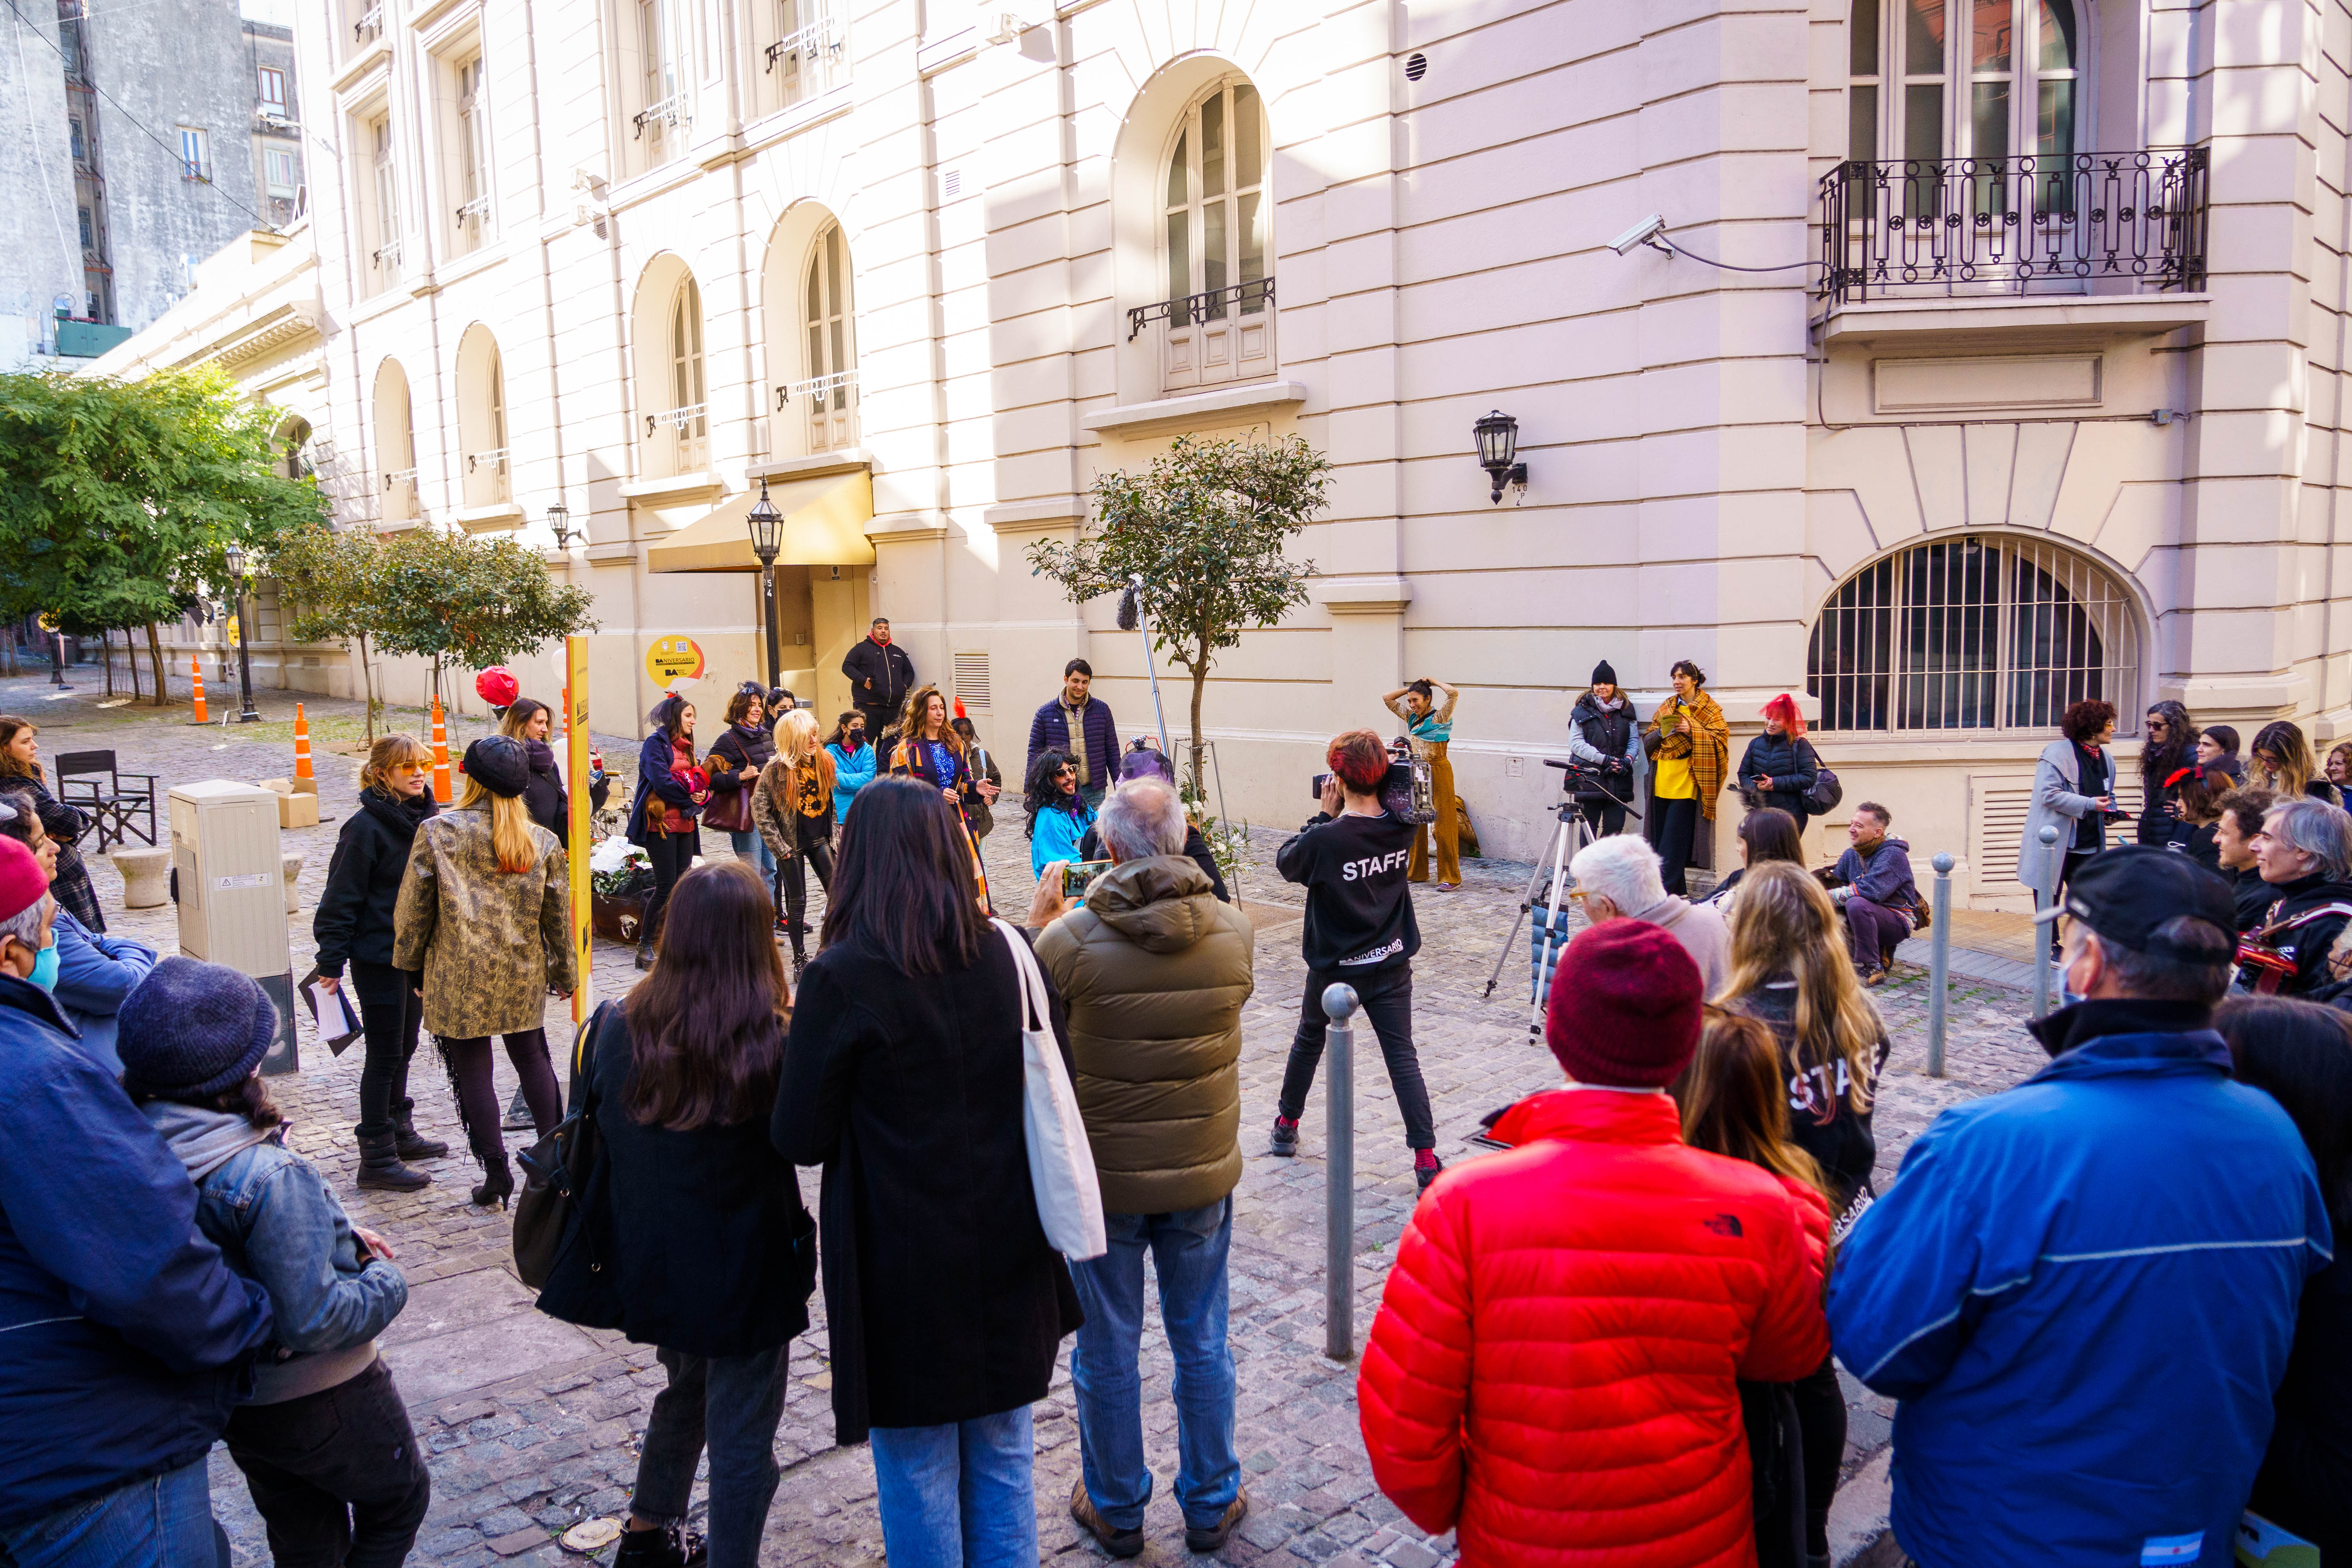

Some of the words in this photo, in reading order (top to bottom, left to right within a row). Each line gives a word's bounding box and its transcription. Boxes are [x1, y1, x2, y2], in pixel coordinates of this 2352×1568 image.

[1512, 485, 1527, 493] 140
[1343, 849, 1406, 881] STAFF
[1789, 1042, 1880, 1110] STAF
[1832, 1185, 1868, 1236] RSARIO
